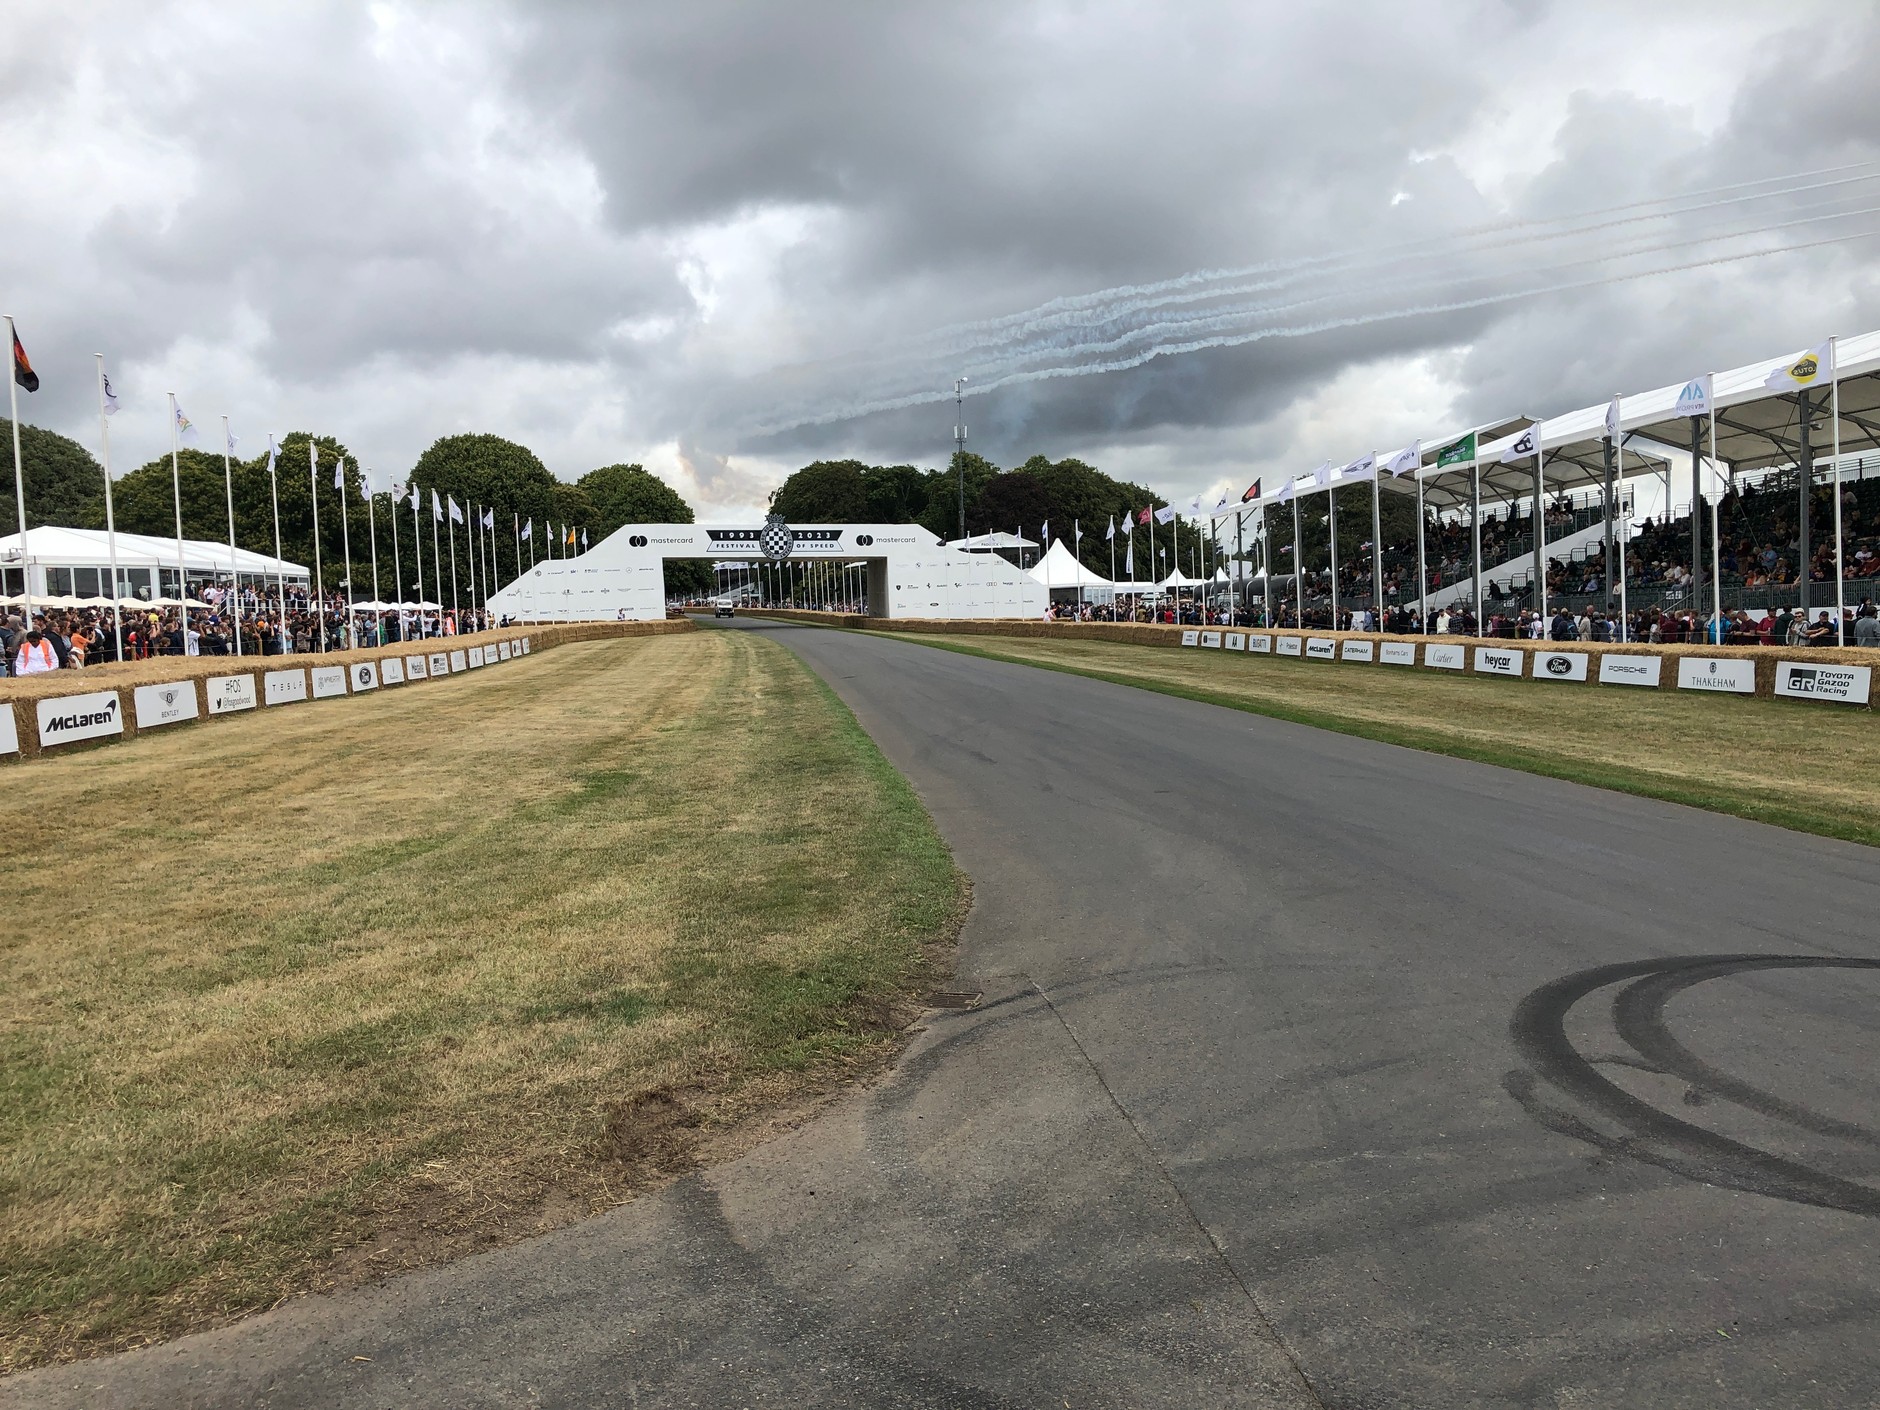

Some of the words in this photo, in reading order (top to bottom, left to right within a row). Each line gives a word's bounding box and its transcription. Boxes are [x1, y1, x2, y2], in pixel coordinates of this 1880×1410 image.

[1308, 645, 1331, 654] McLaren
[1485, 652, 1511, 669] heycar
[1608, 665, 1648, 674] PORSCHE
[1819, 670, 1855, 680] TOYOTA
[225, 679, 241, 694] #FOS
[272, 681, 302, 692] TESLA
[1691, 677, 1736, 689] THAKEHAM
[1788, 677, 1815, 692] GR
[1817, 678, 1850, 688] GAZOO
[1816, 686, 1848, 697] Racing
[161, 709, 179, 718] BENTLEY
[45, 711, 112, 733] McLaren
